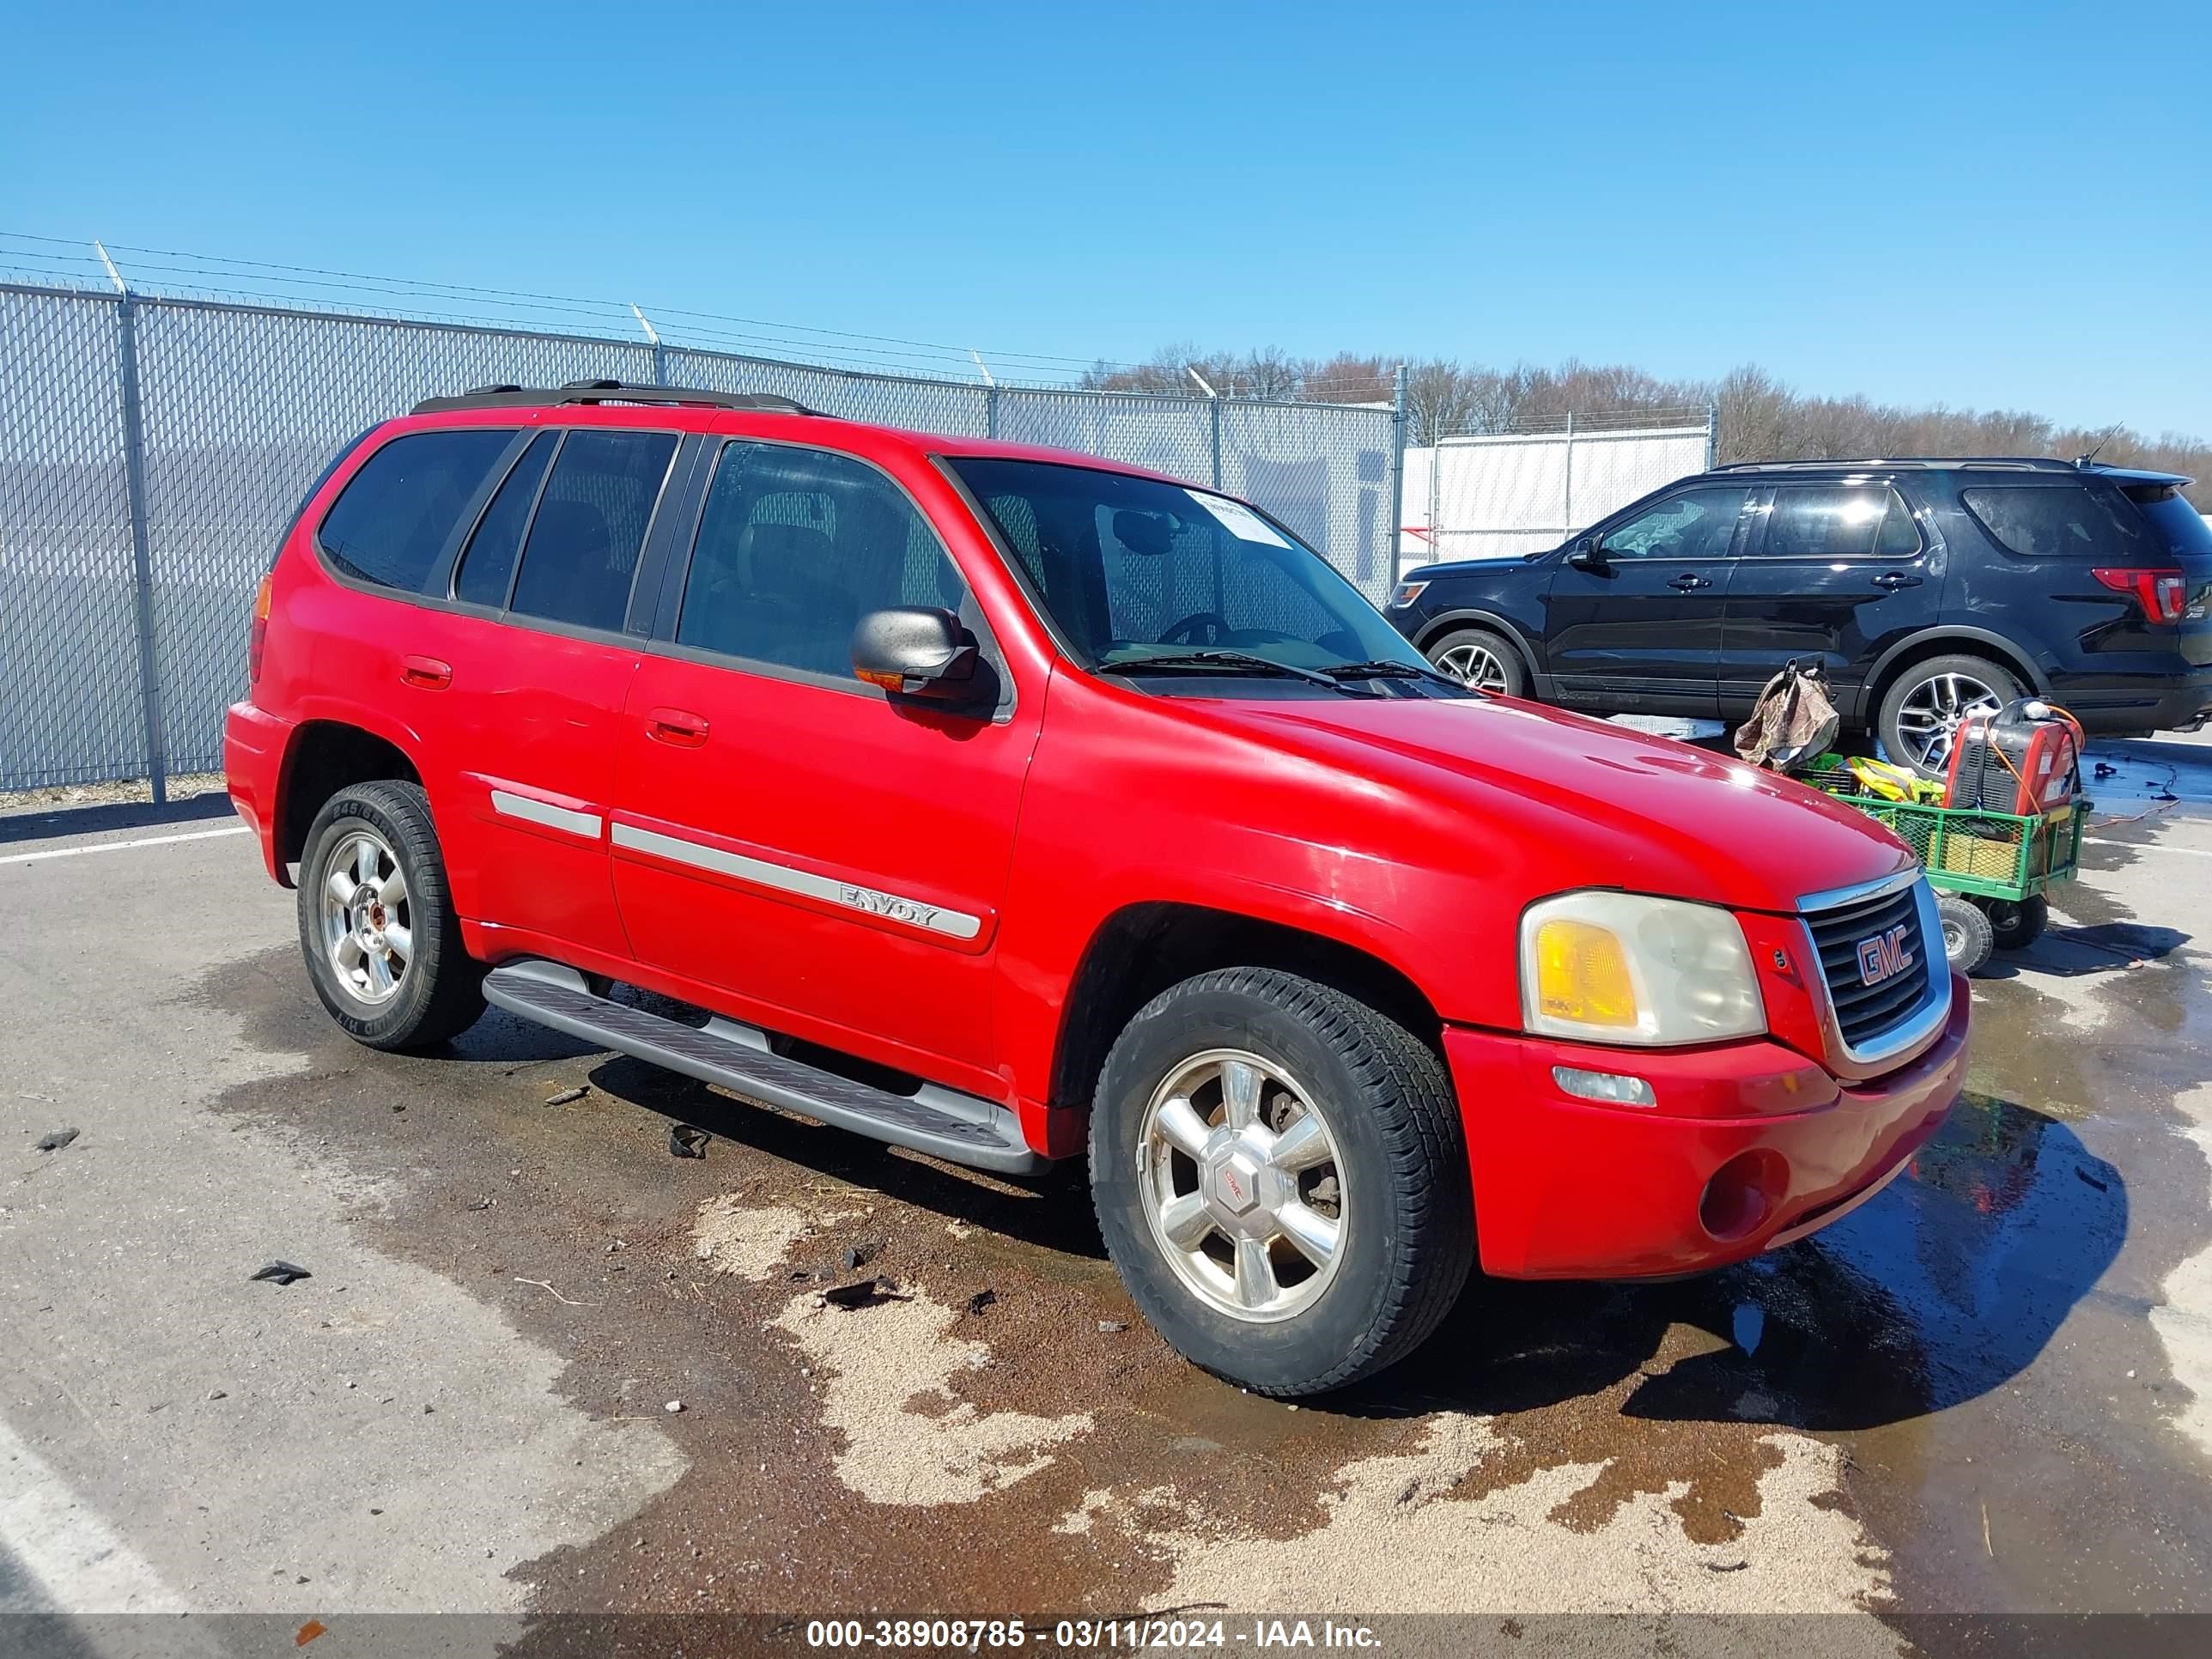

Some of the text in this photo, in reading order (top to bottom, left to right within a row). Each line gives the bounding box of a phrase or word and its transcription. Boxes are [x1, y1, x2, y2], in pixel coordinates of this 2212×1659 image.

[840, 884, 939, 926] ENVOY
[1856, 924, 1913, 987] GMC
[1224, 1170, 1243, 1202] GMC
